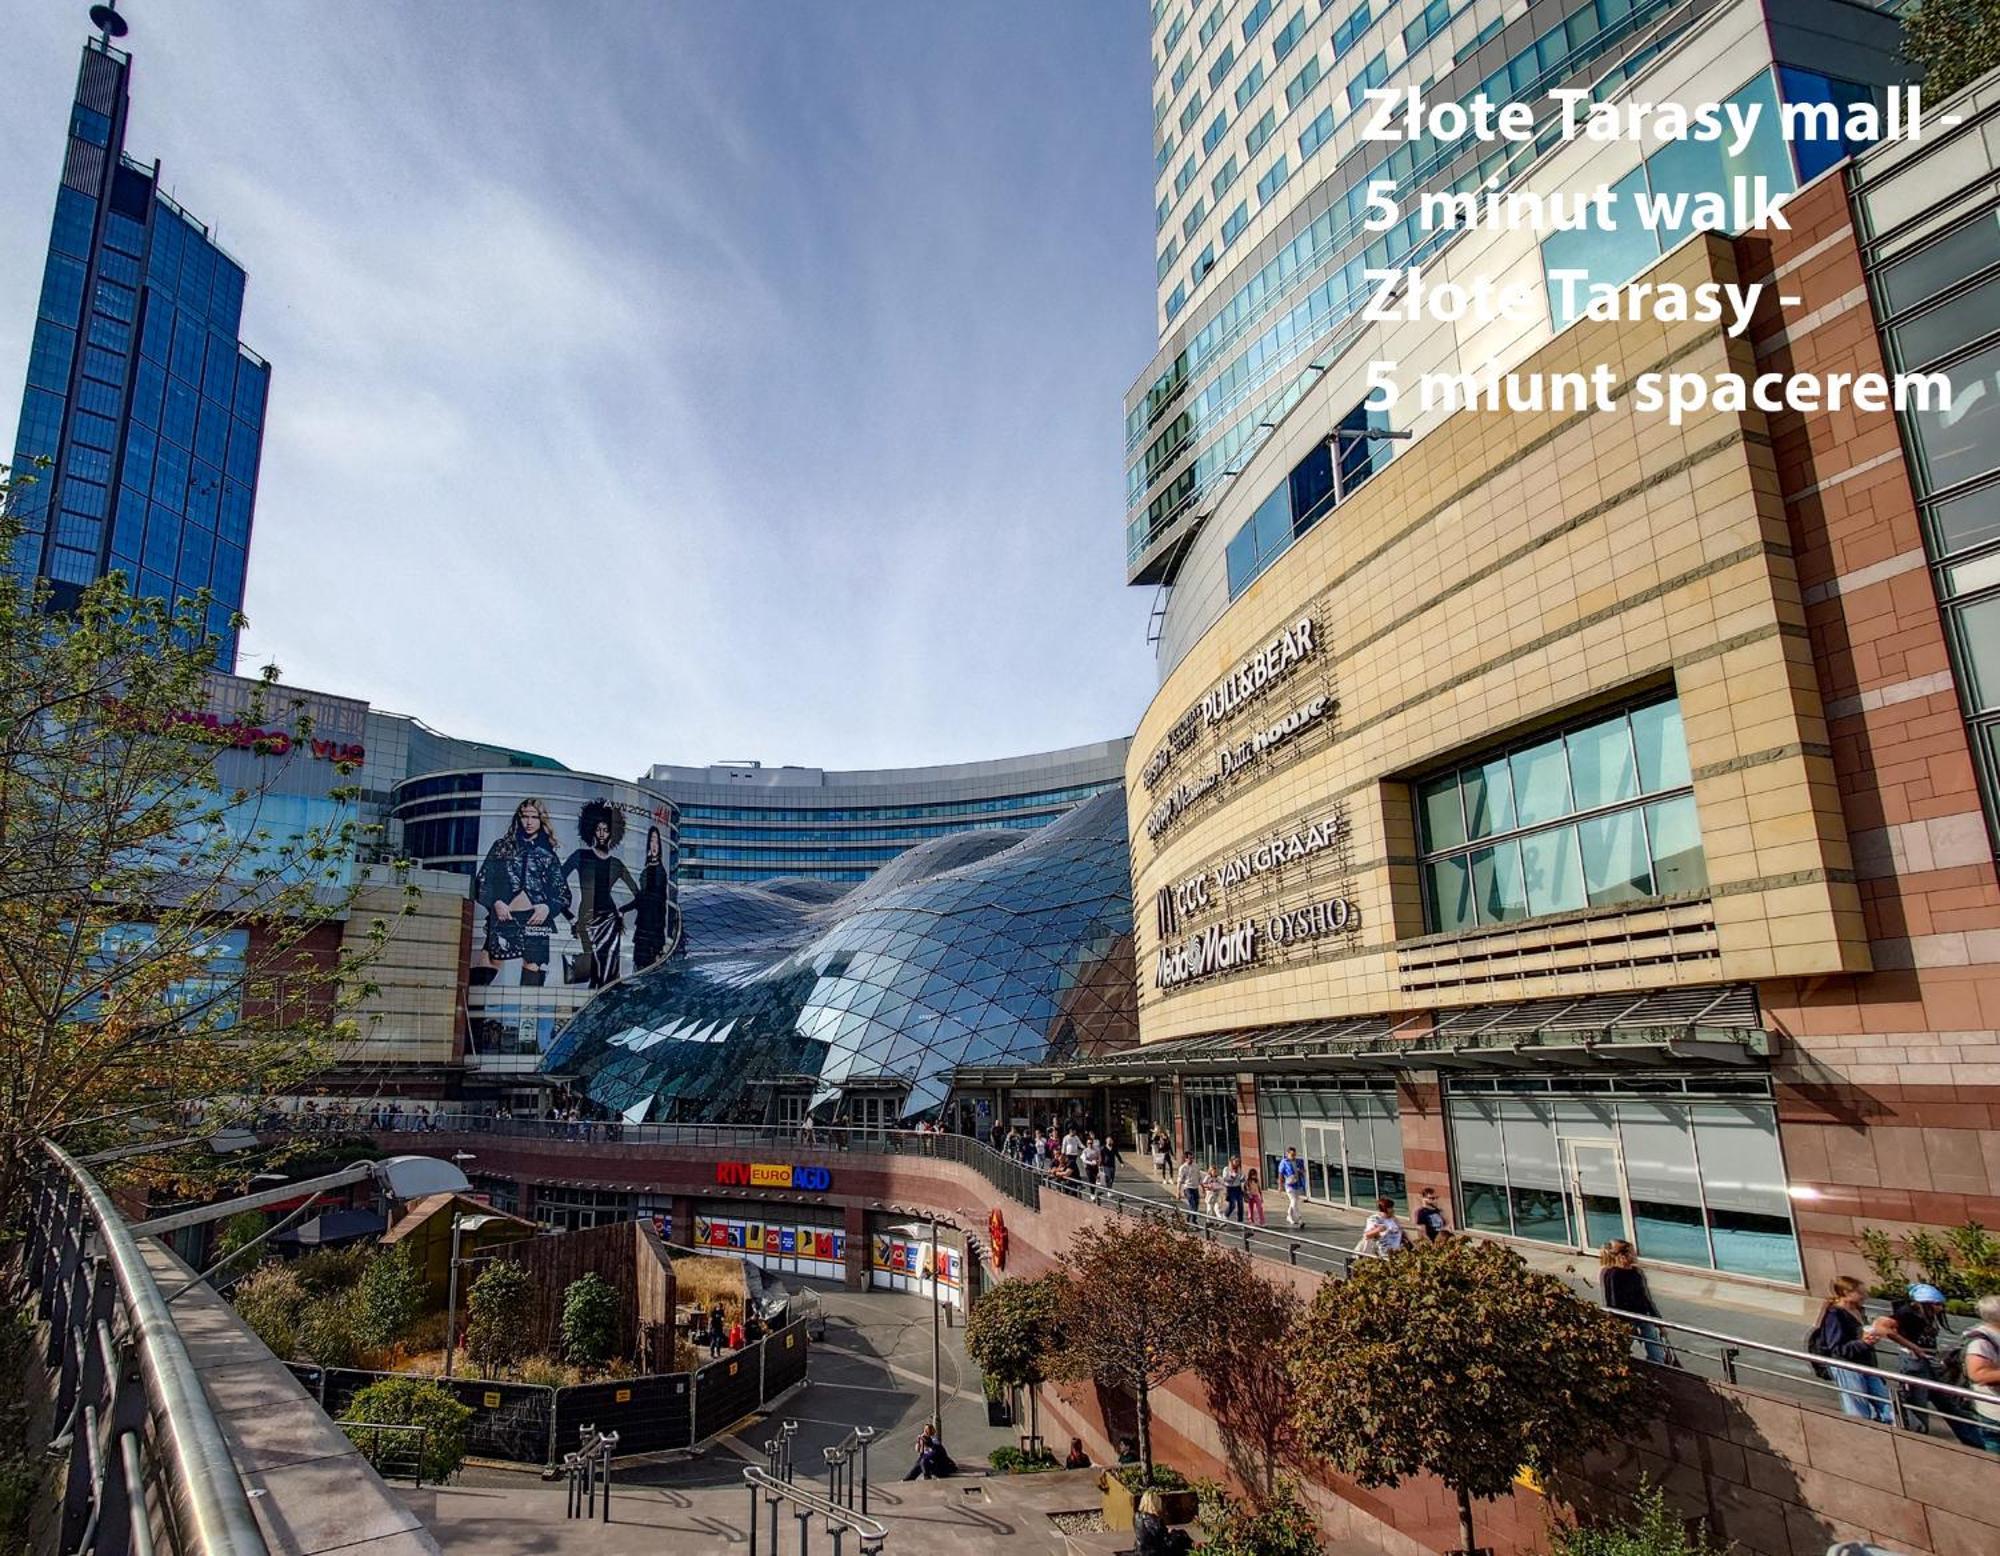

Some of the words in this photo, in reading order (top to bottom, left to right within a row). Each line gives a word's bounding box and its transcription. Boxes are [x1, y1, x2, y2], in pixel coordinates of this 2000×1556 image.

[1202, 618, 1314, 728] PULL&BEAR
[1215, 854, 1251, 886] VAN
[1256, 817, 1338, 870] GRAAF
[1177, 874, 1209, 915] CCC
[1268, 898, 1348, 944] OYSHO
[716, 1162, 751, 1186] RTV
[752, 1169, 790, 1181] EURO
[794, 1165, 831, 1190] AGD
